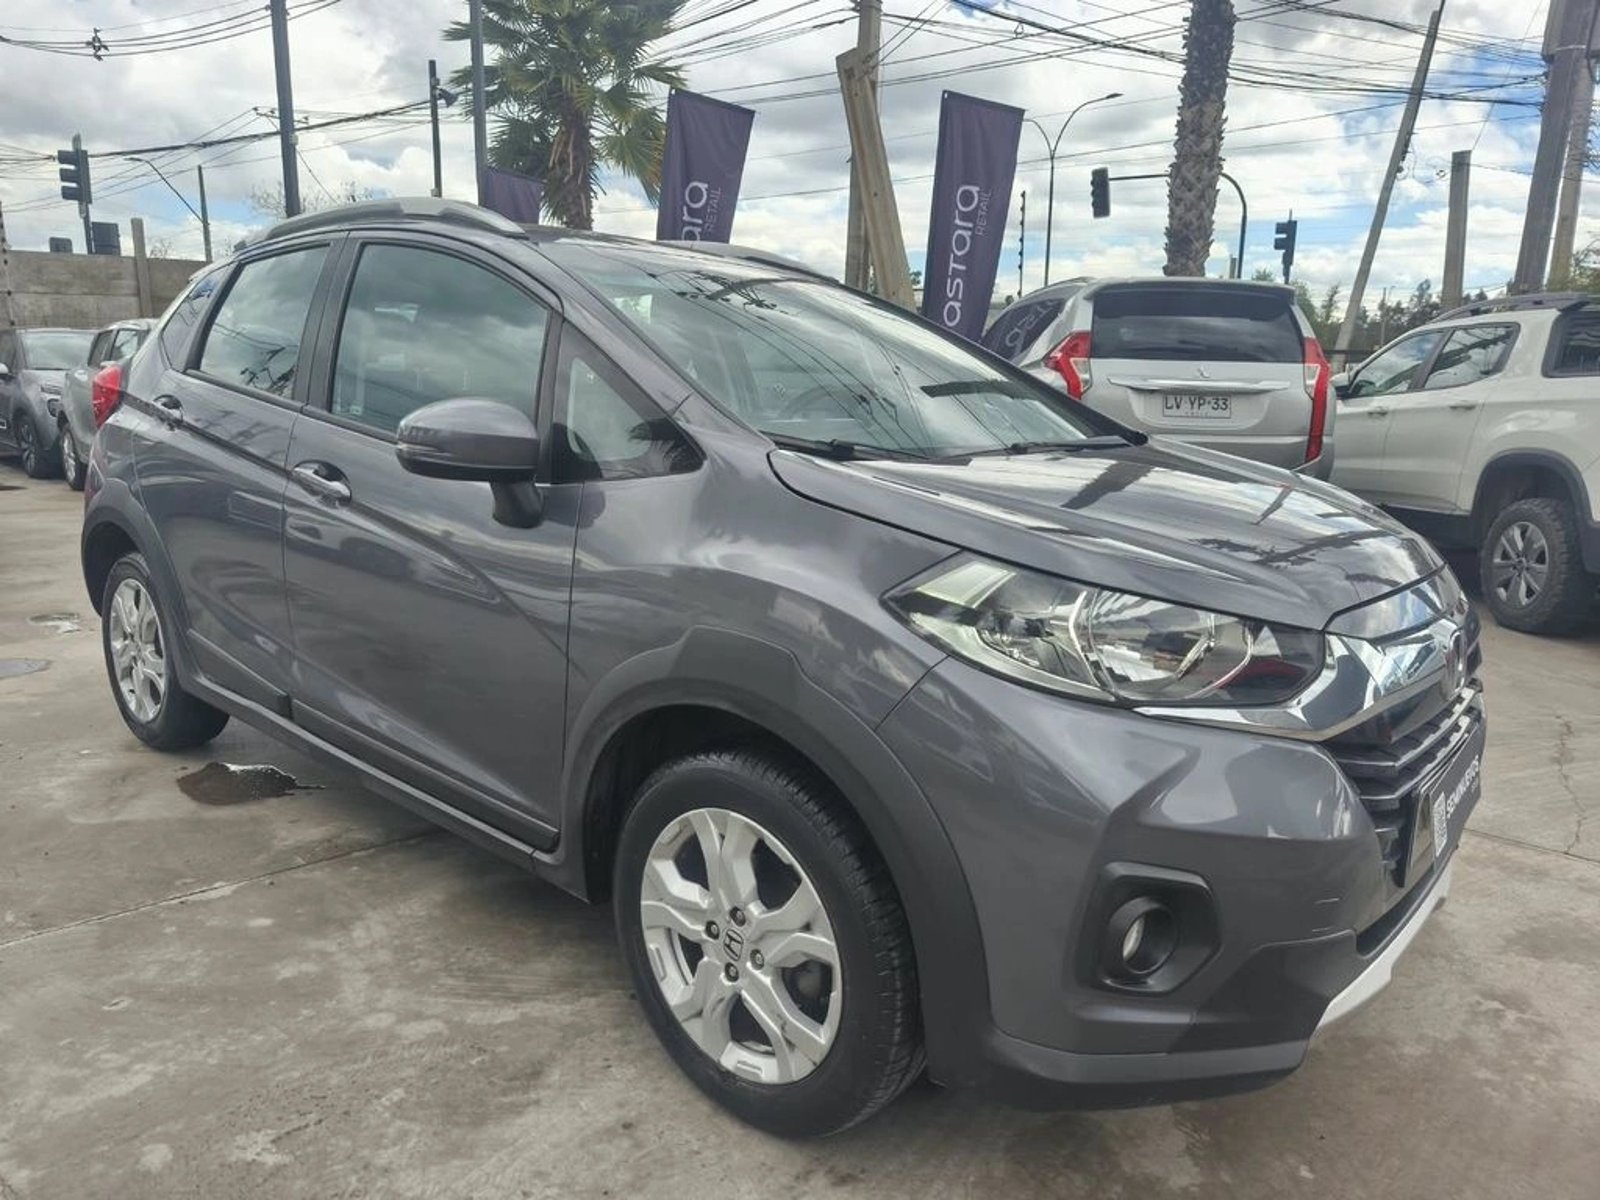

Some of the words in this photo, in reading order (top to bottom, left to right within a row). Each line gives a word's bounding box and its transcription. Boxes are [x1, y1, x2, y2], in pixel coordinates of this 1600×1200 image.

[703, 186, 721, 234] RETAIL
[974, 189, 992, 236] RETAIL
[943, 184, 980, 327] astara
